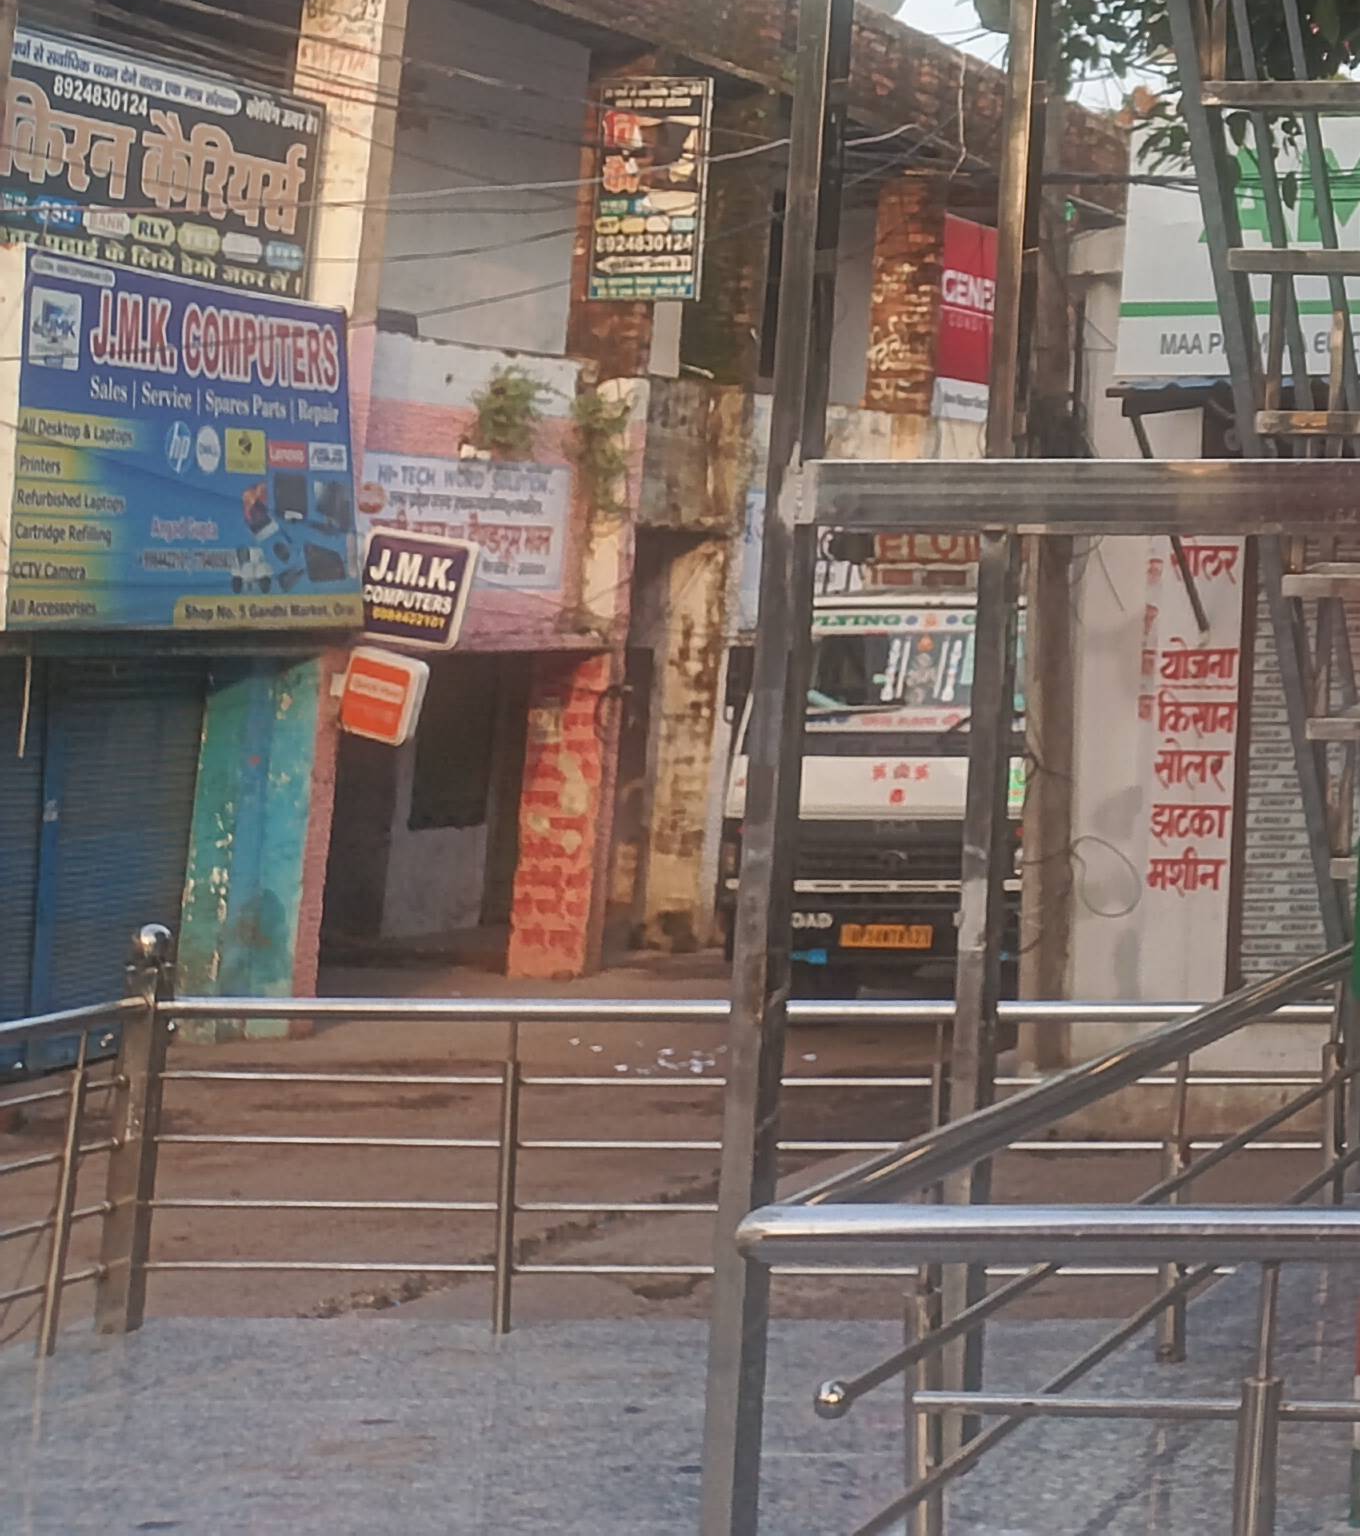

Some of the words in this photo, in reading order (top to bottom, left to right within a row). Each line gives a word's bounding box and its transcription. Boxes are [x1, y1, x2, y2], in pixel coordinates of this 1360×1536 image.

[53, 74, 149, 118] 8924830124
[141, 108, 307, 235] कैरियर्स
[138, 219, 170, 241] RLY
[90, 289, 177, 374] J.M.K.
[182, 303, 340, 394] COMPUTERS
[1160, 332, 1203, 355] MAA
[90, 376, 127, 402] Sales
[142, 381, 192, 411] Service
[205, 390, 249, 417] Spares
[252, 393, 286, 419] Parts
[298, 397, 339, 426] Repair
[22, 418, 37, 435] All
[39, 421, 81, 443] Desktop
[83, 423, 91, 440] &
[94, 425, 133, 448] Laptops
[170, 420, 191, 474] hp
[19, 455, 61, 476] Printers
[17, 488, 82, 511] Refurbished
[84, 493, 125, 514] Laptops
[15, 524, 66, 546] Cartridge
[69, 526, 112, 547] Refilling
[11, 561, 43, 580] CCTV
[44, 563, 86, 581] Camera
[370, 548, 456, 592] J.M.K.
[10, 599, 25, 616] All
[185, 604, 214, 623] Shop
[364, 584, 452, 615] COMPUTERS
[1160, 637, 1238, 680] योजना
[1158, 690, 1237, 738] किसान
[1154, 738, 1230, 792] सोलर
[1151, 803, 1231, 846] झटका
[1147, 847, 1228, 897] मशीन
